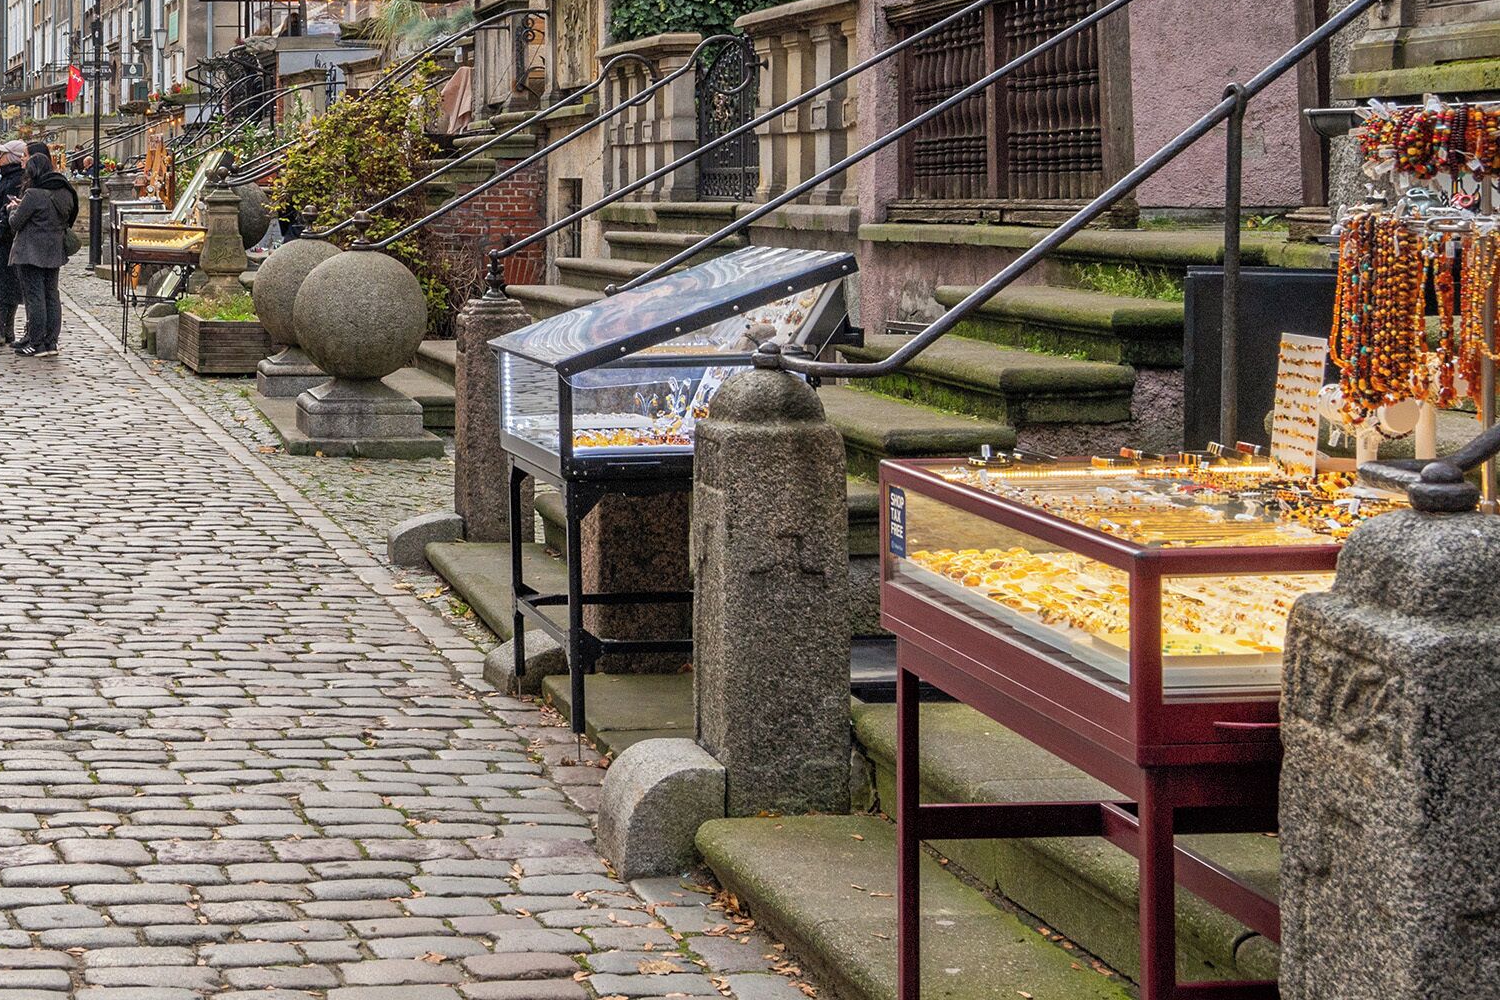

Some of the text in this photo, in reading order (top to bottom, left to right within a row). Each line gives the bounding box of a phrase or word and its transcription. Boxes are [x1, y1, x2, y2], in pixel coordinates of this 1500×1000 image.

[890, 492, 905, 510] SHOP
[890, 506, 902, 524] TAX
[890, 521, 904, 539] FREE
